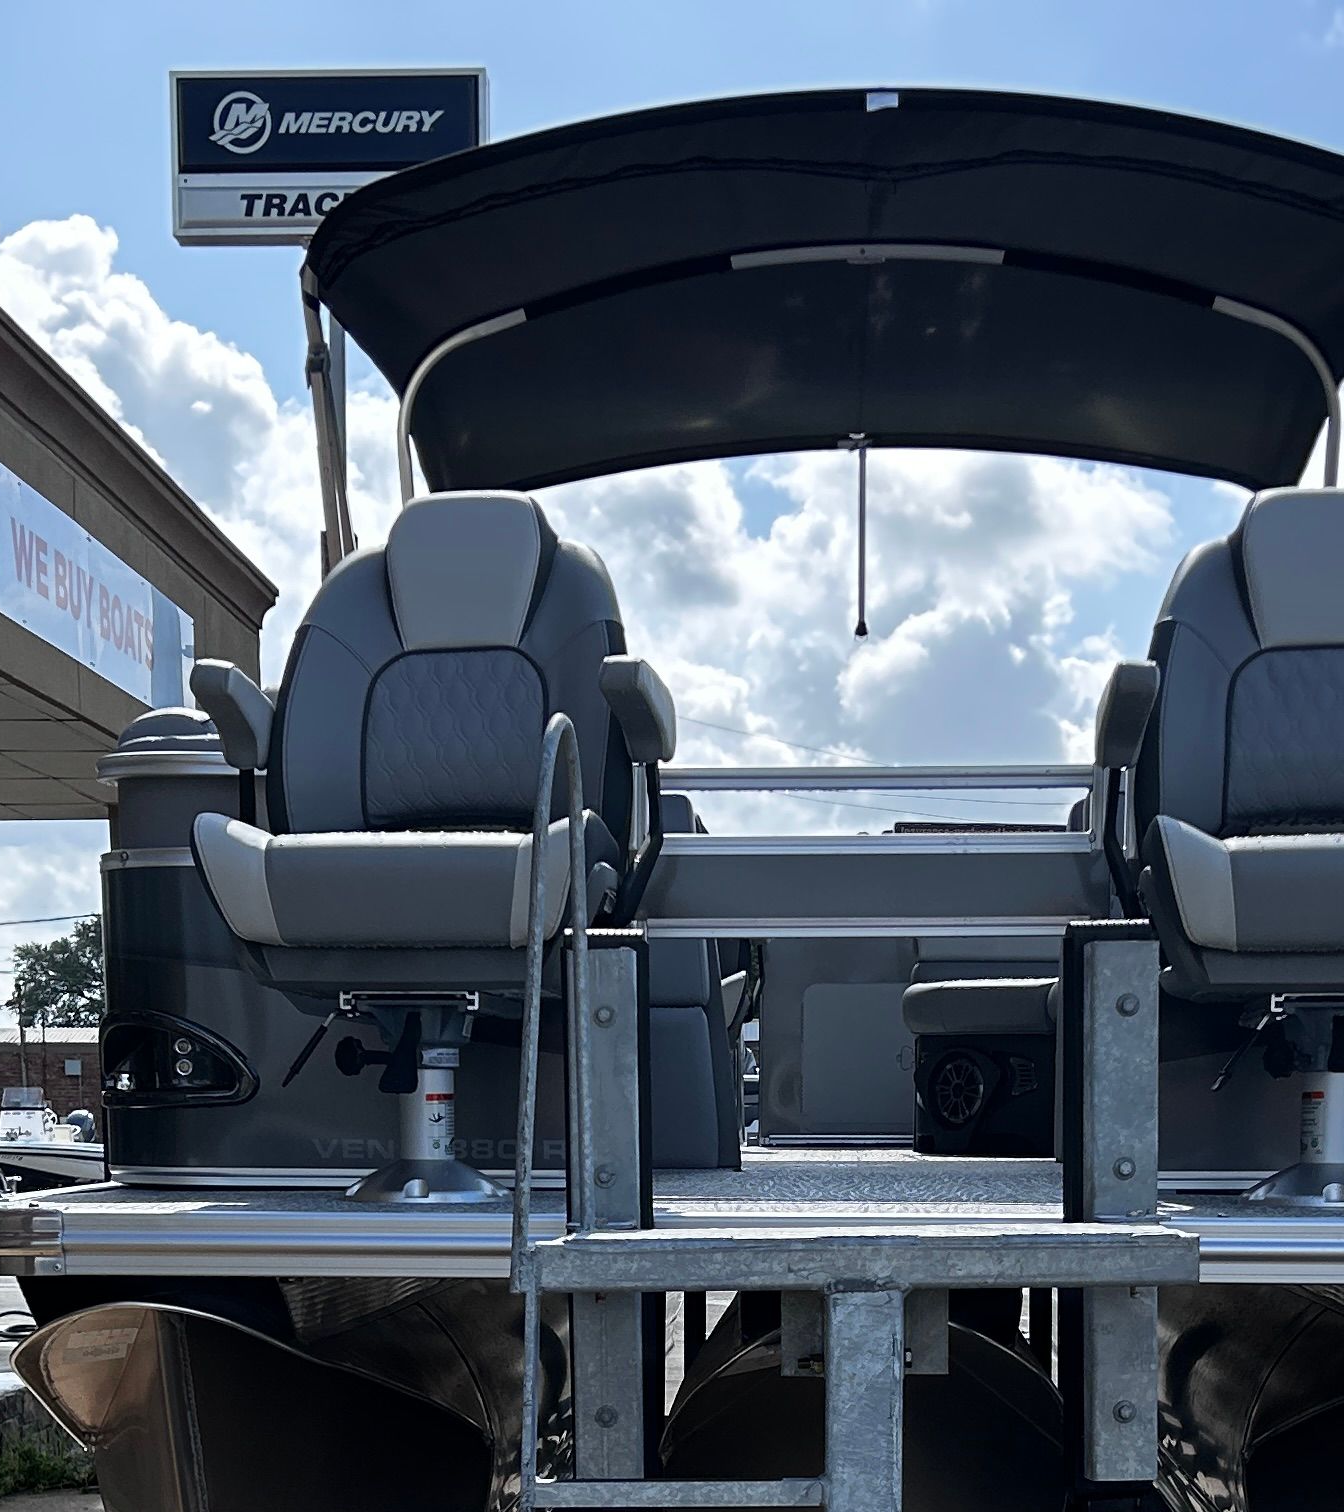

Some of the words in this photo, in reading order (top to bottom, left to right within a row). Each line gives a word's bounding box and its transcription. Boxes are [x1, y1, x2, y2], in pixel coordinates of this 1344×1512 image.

[278, 110, 444, 134] MERCURY
[240, 192, 354, 217] TRAC
[11, 516, 49, 600] WE
[54, 548, 94, 629] BUY
[99, 582, 154, 671] BOATS
